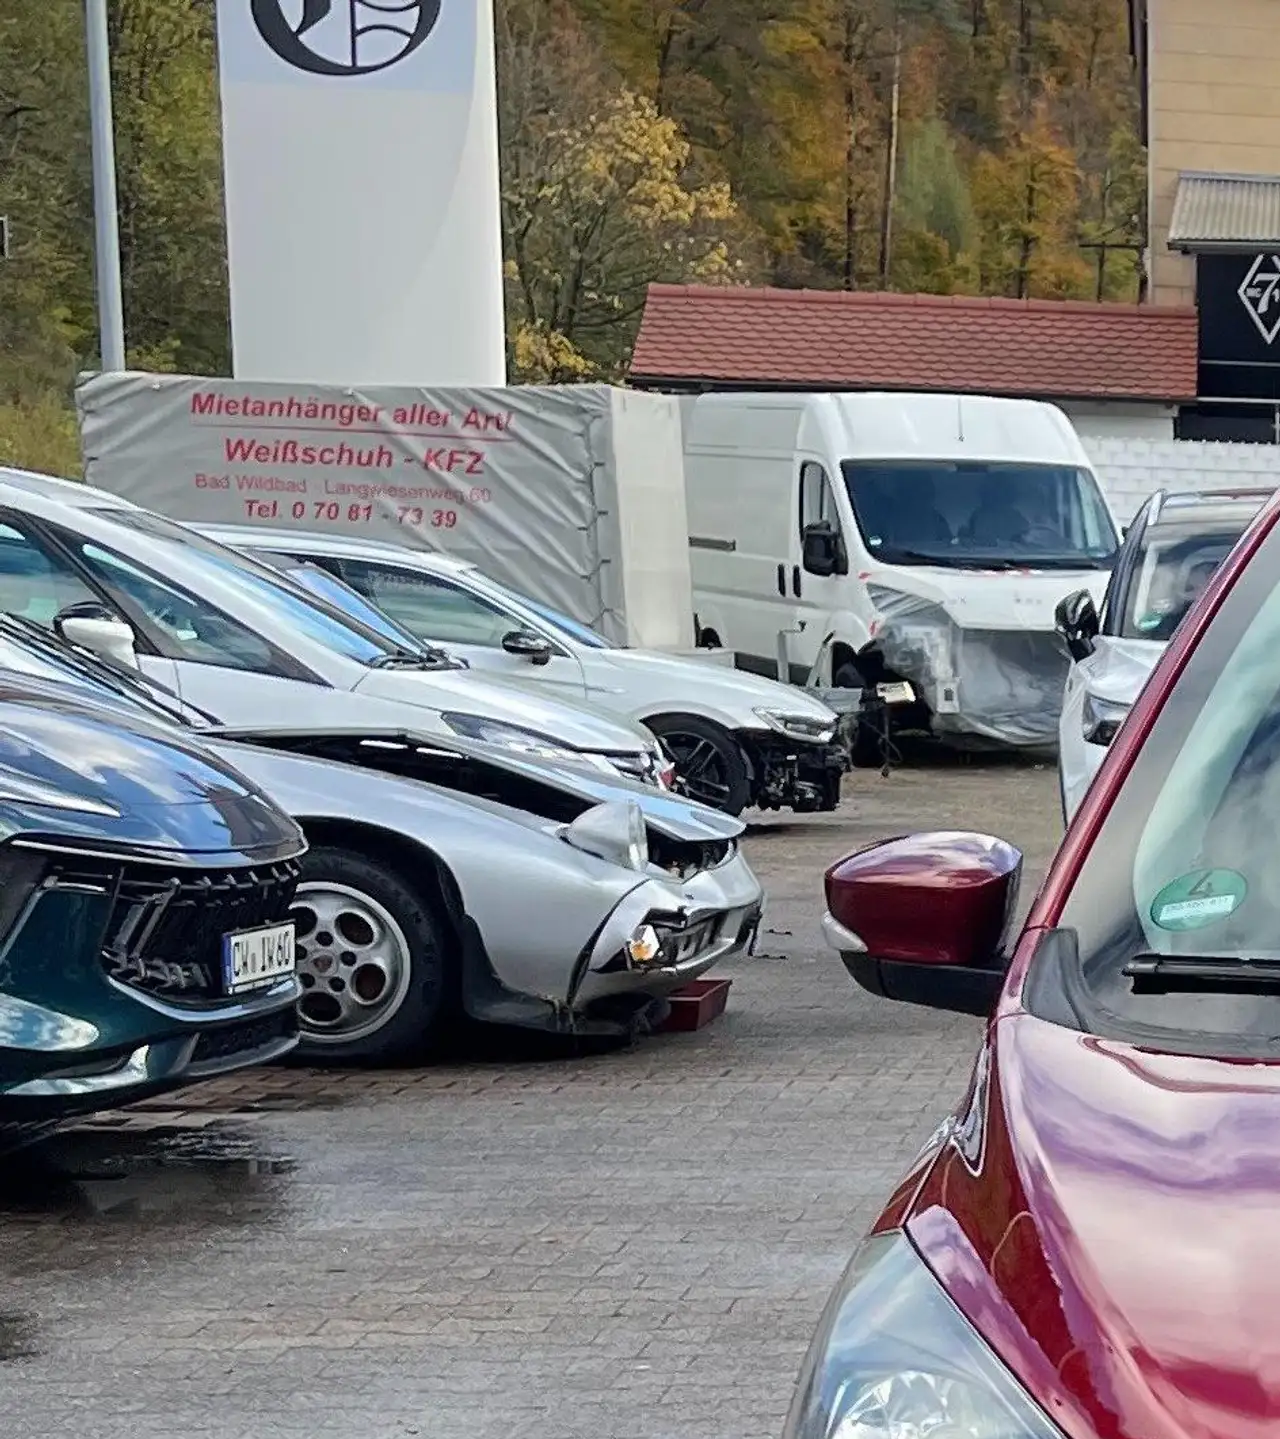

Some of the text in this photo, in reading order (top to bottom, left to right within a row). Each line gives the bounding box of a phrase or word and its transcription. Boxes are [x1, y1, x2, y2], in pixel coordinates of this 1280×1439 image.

[190, 391, 382, 426] Mietanhänger
[392, 402, 449, 428] aller
[223, 437, 393, 469] Weißschuh
[423, 446, 485, 475] KFZ
[194, 472, 230, 490] Bad
[234, 474, 307, 493] Wildbad
[291, 501, 306, 520] 0
[313, 501, 340, 521] 70
[347, 503, 373, 522] 81
[397, 505, 424, 526] 73
[430, 508, 458, 529] 39
